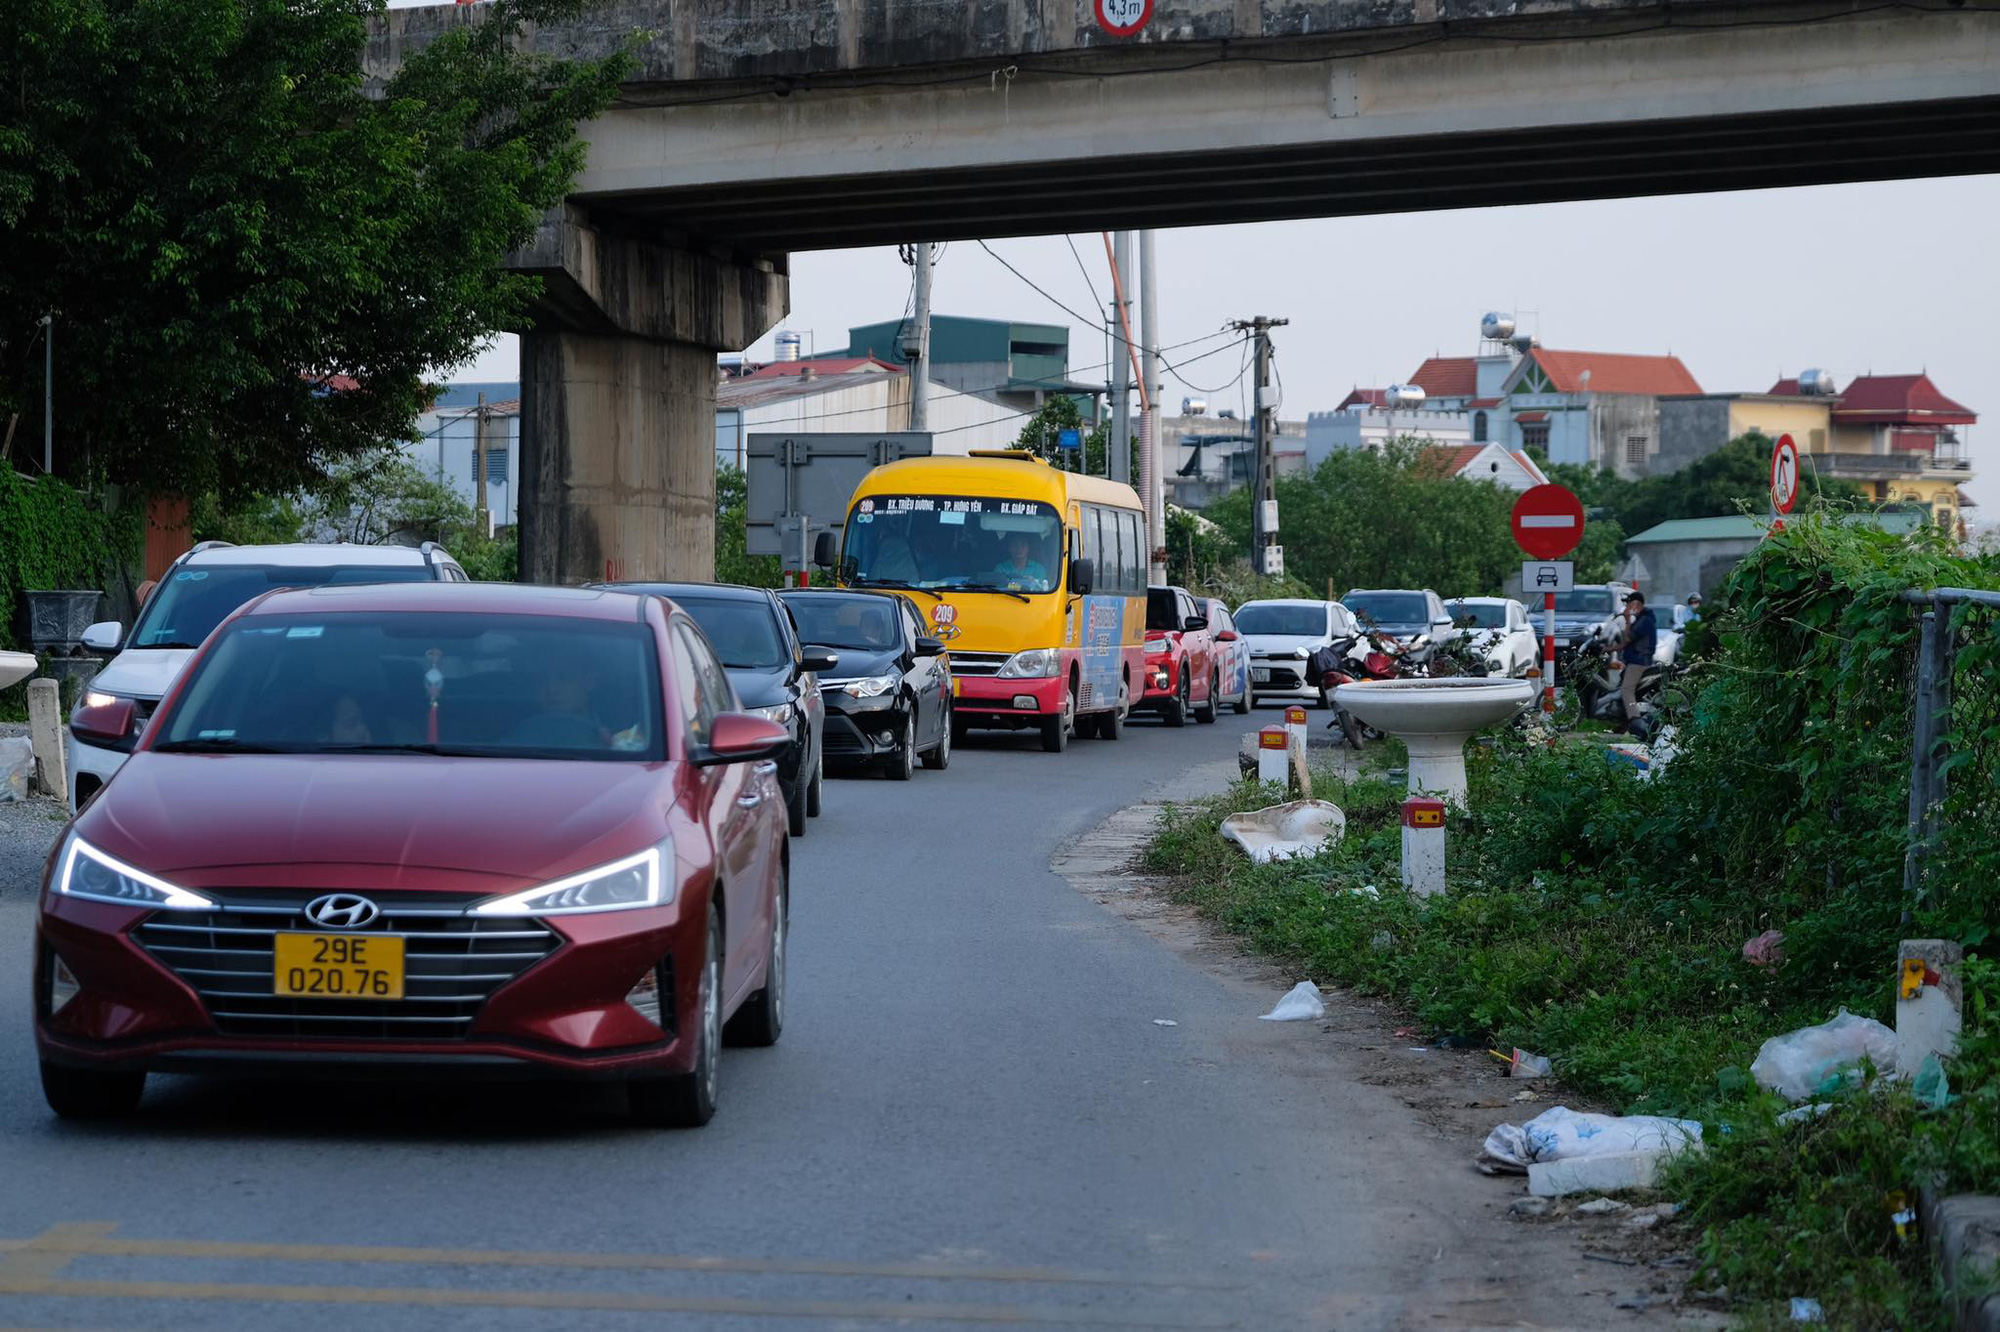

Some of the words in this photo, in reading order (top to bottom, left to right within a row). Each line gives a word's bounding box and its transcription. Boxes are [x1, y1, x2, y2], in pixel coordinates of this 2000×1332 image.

[860, 500, 874, 513] 209
[935, 605, 953, 623] 209
[312, 937, 367, 964] 29E
[288, 967, 389, 996] 020.76
